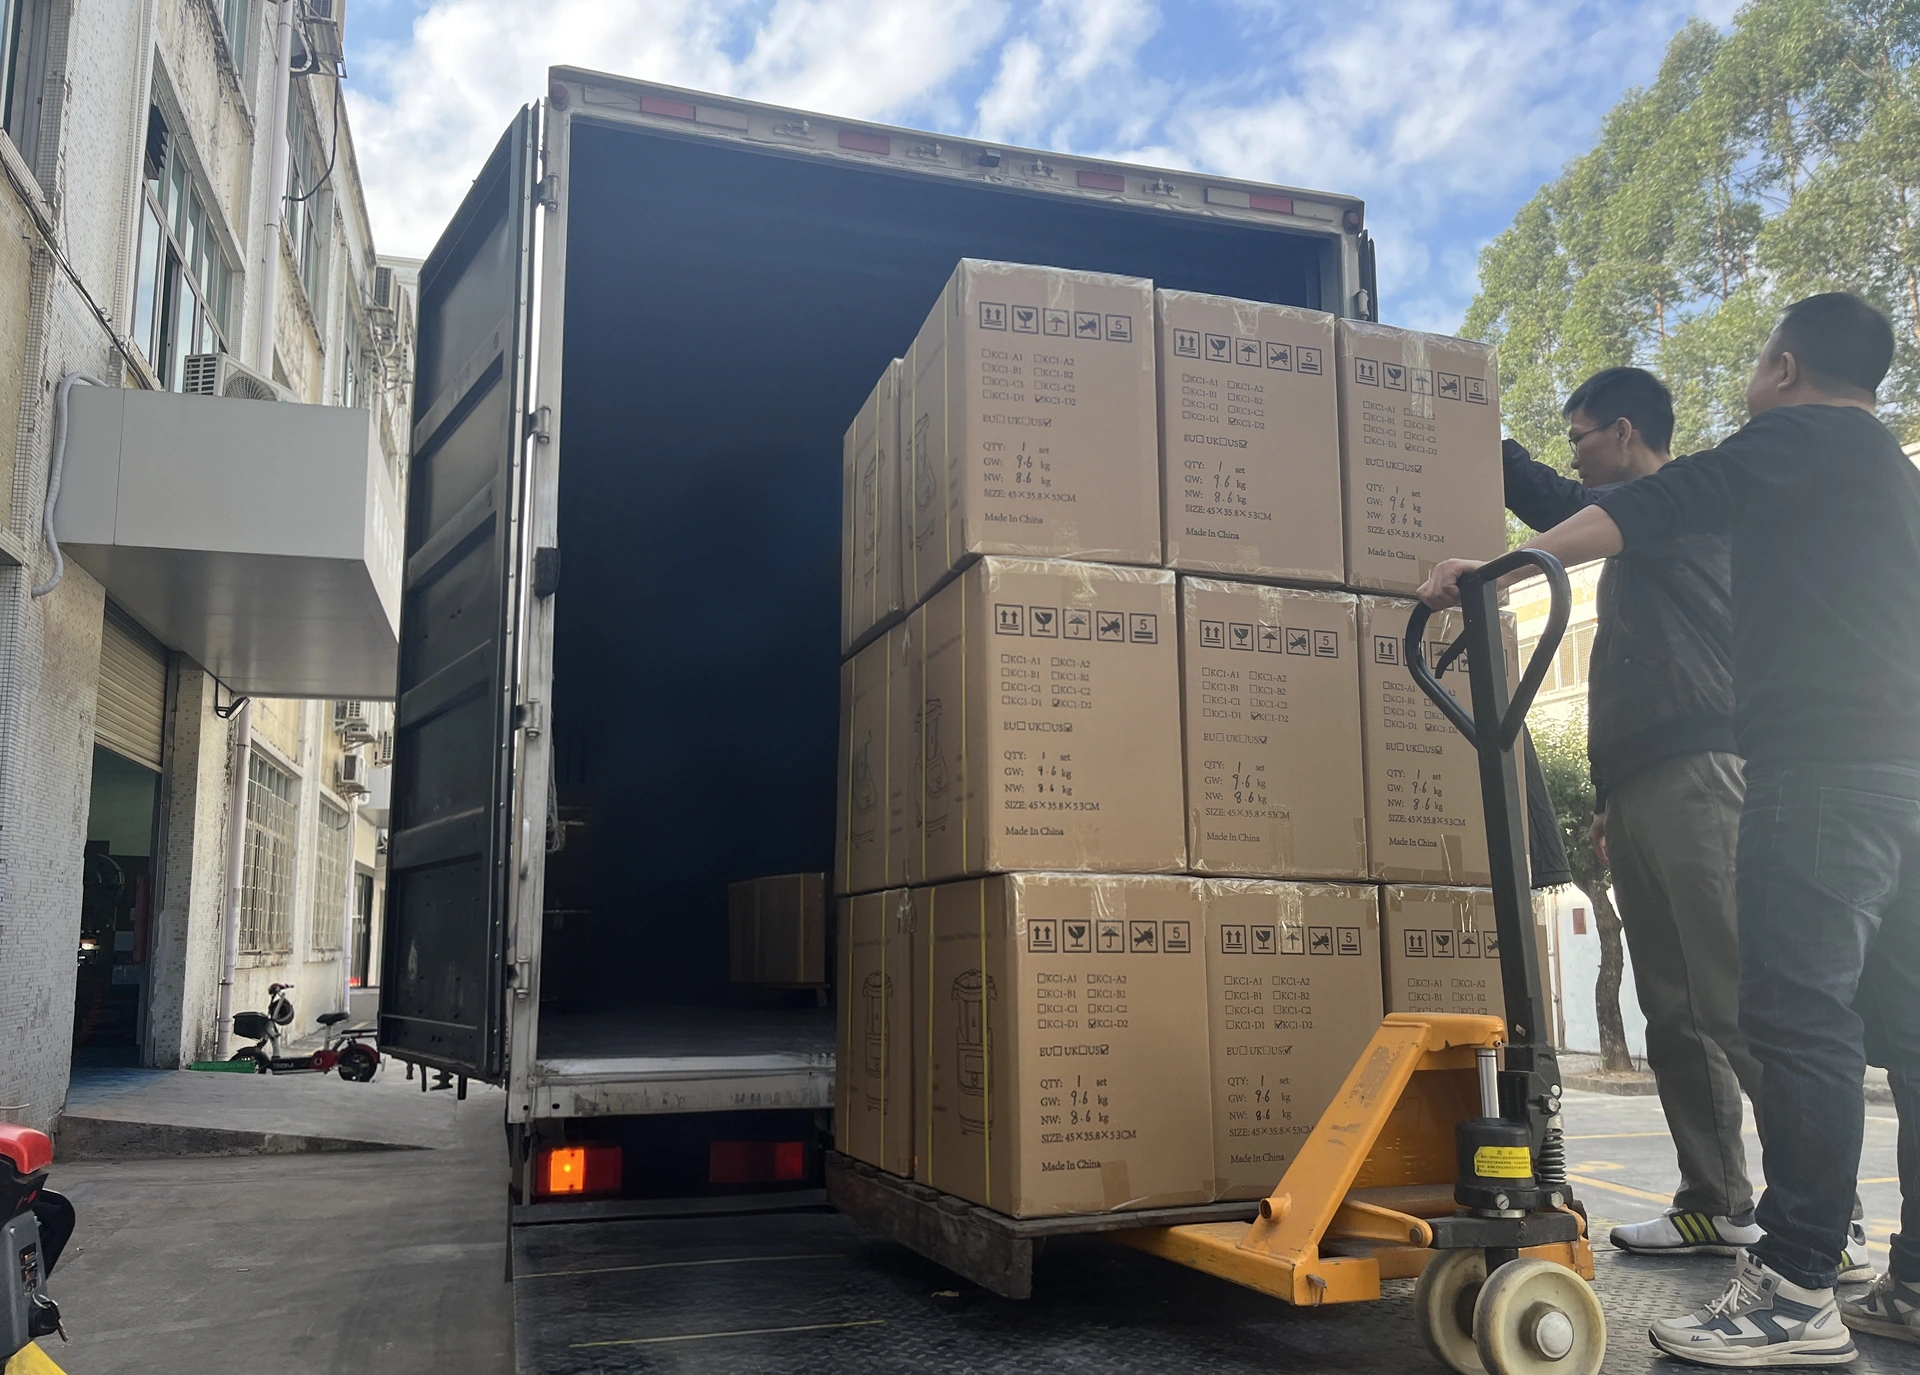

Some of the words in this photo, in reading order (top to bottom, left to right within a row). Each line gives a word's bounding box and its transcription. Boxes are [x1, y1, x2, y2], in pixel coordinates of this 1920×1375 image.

[991, 351, 1024, 362] KC1-A1
[1043, 355, 1075, 366] KC1-A2
[991, 364, 1022, 375] KC1-B1
[1043, 368, 1074, 379] KC1-B2
[1191, 399, 1219, 411] KC1-C1
[1236, 405, 1264, 417] KC1-C2
[1370, 401, 1396, 414] KC1-A1
[1191, 412, 1220, 424] KC1-D1
[1236, 417, 1265, 430] KC1-D2
[1371, 413, 1395, 425] KC1-B1
[1411, 420, 1436, 432] KC1-B2
[1371, 424, 1397, 437] KC1-C1
[1411, 431, 1437, 444] KC1-C2
[983, 441, 1005, 453] QTY:
[1038, 446, 1050, 455] set
[1371, 436, 1398, 449] KC1-D1
[1411, 443, 1438, 456] KC1-D2
[983, 457, 1003, 467] GW:
[1040, 460, 1050, 472] kg
[1184, 459, 1205, 470] QTY:
[1235, 465, 1245, 474] set
[984, 473, 1003, 483] NW:
[1040, 476, 1051, 487] kg
[984, 513, 1008, 523] Made
[1009, 514, 1018, 523] In
[1019, 514, 1043, 524] China
[1185, 526, 1207, 537] Made
[1208, 529, 1216, 538] In
[1217, 529, 1239, 540] China
[1367, 547, 1387, 556] Made
[1387, 550, 1395, 558] In
[1395, 551, 1416, 560] China
[1010, 655, 1041, 665] KC1-A1
[1059, 658, 1090, 668] KC1-A2
[1010, 668, 1040, 679] KC1-B1
[1059, 672, 1090, 682] KC1-B2
[1210, 668, 1240, 678] KC1-A1
[1257, 672, 1287, 682] KC1-A2
[1010, 682, 1042, 693] KC1-C1
[1060, 685, 1091, 696] KC1-C2
[1211, 681, 1239, 692] KC1-B1
[1258, 685, 1286, 696] KC1-B2
[1389, 681, 1416, 693] KC1-A1
[1011, 696, 1042, 707] KC1-D1
[1060, 699, 1092, 710] KC1-D2
[1211, 695, 1241, 706] KC1-C1
[1258, 698, 1288, 709] KC1-C2
[1390, 694, 1415, 705] KC1-B1
[1211, 709, 1242, 720] KC1-D1
[1259, 712, 1289, 723] KC1-D2
[1390, 706, 1417, 718] KC1-C1
[1391, 719, 1417, 730] KC1-D1
[1204, 760, 1225, 771] QTY:
[1255, 763, 1265, 772] set
[1386, 769, 1405, 779] QTY:
[1432, 771, 1441, 781] set
[1204, 776, 1223, 786] GW:
[1257, 777, 1266, 789] kg
[1387, 784, 1404, 793] GW:
[1433, 786, 1443, 797] kg
[1205, 792, 1224, 801] NW:
[1258, 793, 1267, 805] kg
[1387, 798, 1405, 808] NW:
[1434, 801, 1444, 812] kg
[1205, 807, 1226, 817] SIZE:
[1005, 826, 1029, 836] Made
[1029, 826, 1039, 836] In
[1040, 826, 1064, 836] China
[1206, 832, 1228, 842] Made
[1229, 833, 1237, 842] In
[1238, 833, 1260, 843] China
[1389, 837, 1408, 846] Made
[1408, 837, 1417, 847] In
[1417, 837, 1438, 847] China
[1046, 974, 1077, 984] KC1-A1
[1096, 974, 1127, 984] KC1-A2
[1233, 976, 1263, 986] KC1-A1
[1280, 976, 1311, 986] KC1-A2
[1415, 979, 1443, 987] KC1-A1
[1458, 979, 1486, 988] KC1-A2
[1046, 989, 1077, 999] KC1-B1
[1096, 989, 1126, 999] KC1-B2
[1233, 991, 1262, 1001] KC1-B1
[1281, 991, 1310, 1001] KC1-B2
[1415, 993, 1442, 1001] KC1-B1
[1459, 994, 1486, 1002] KC1-B2
[1047, 1004, 1078, 1014] KC1-C1
[1096, 1004, 1128, 1014] KC1-C2
[1234, 1005, 1264, 1015] KC1-C1
[1281, 1005, 1312, 1015] KC1-C2
[1047, 1019, 1079, 1029] KC1-D1
[1097, 1019, 1128, 1029] KC1-D2
[1235, 1020, 1265, 1030] KC1-D1
[1282, 1020, 1313, 1030] KC1-D2
[1040, 1078, 1063, 1090] QTY:
[1096, 1077, 1107, 1087] set
[1227, 1077, 1249, 1088] QTY:
[1279, 1077, 1290, 1085] set
[1040, 1096, 1060, 1107] GW:
[1097, 1095, 1108, 1107] kg
[1228, 1094, 1247, 1103] GW:
[1281, 1092, 1291, 1104] kg
[1040, 1115, 1061, 1125] NW:
[1098, 1113, 1109, 1124] kg
[1229, 1110, 1248, 1120] NW:
[1282, 1109, 1292, 1120] kg
[1229, 1127, 1250, 1137] SIZE:
[1041, 1133, 1064, 1144] SIZE:
[1230, 1154, 1252, 1164] Made
[1253, 1153, 1262, 1163] In
[1262, 1152, 1285, 1162] China
[1041, 1161, 1065, 1172] Made
[1066, 1160, 1076, 1170] In
[1076, 1159, 1101, 1170] China
